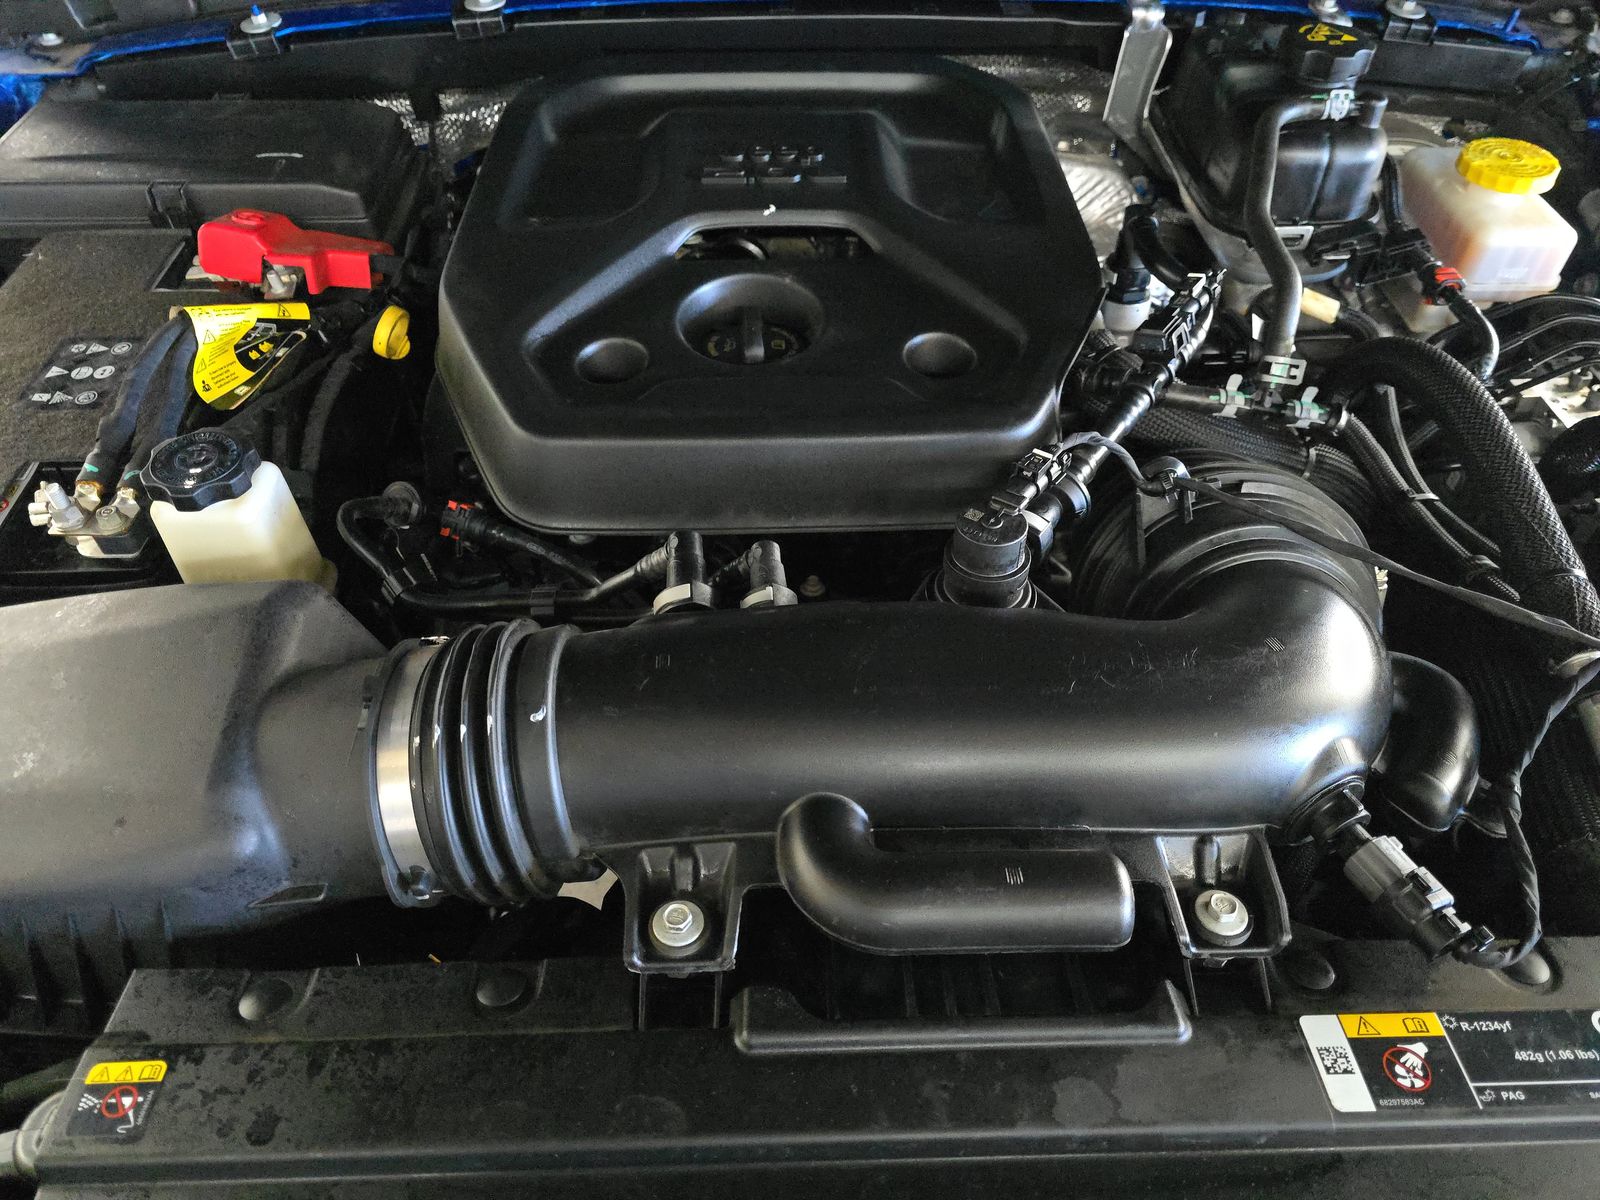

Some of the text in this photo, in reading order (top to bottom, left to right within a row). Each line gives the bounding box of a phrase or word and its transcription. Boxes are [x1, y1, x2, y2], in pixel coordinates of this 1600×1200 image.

[1460, 1020, 1512, 1032] R-1234yf
[1514, 1049, 1600, 1063] 482g (1.06 lbs)
[1501, 1091, 1525, 1101] PAG
